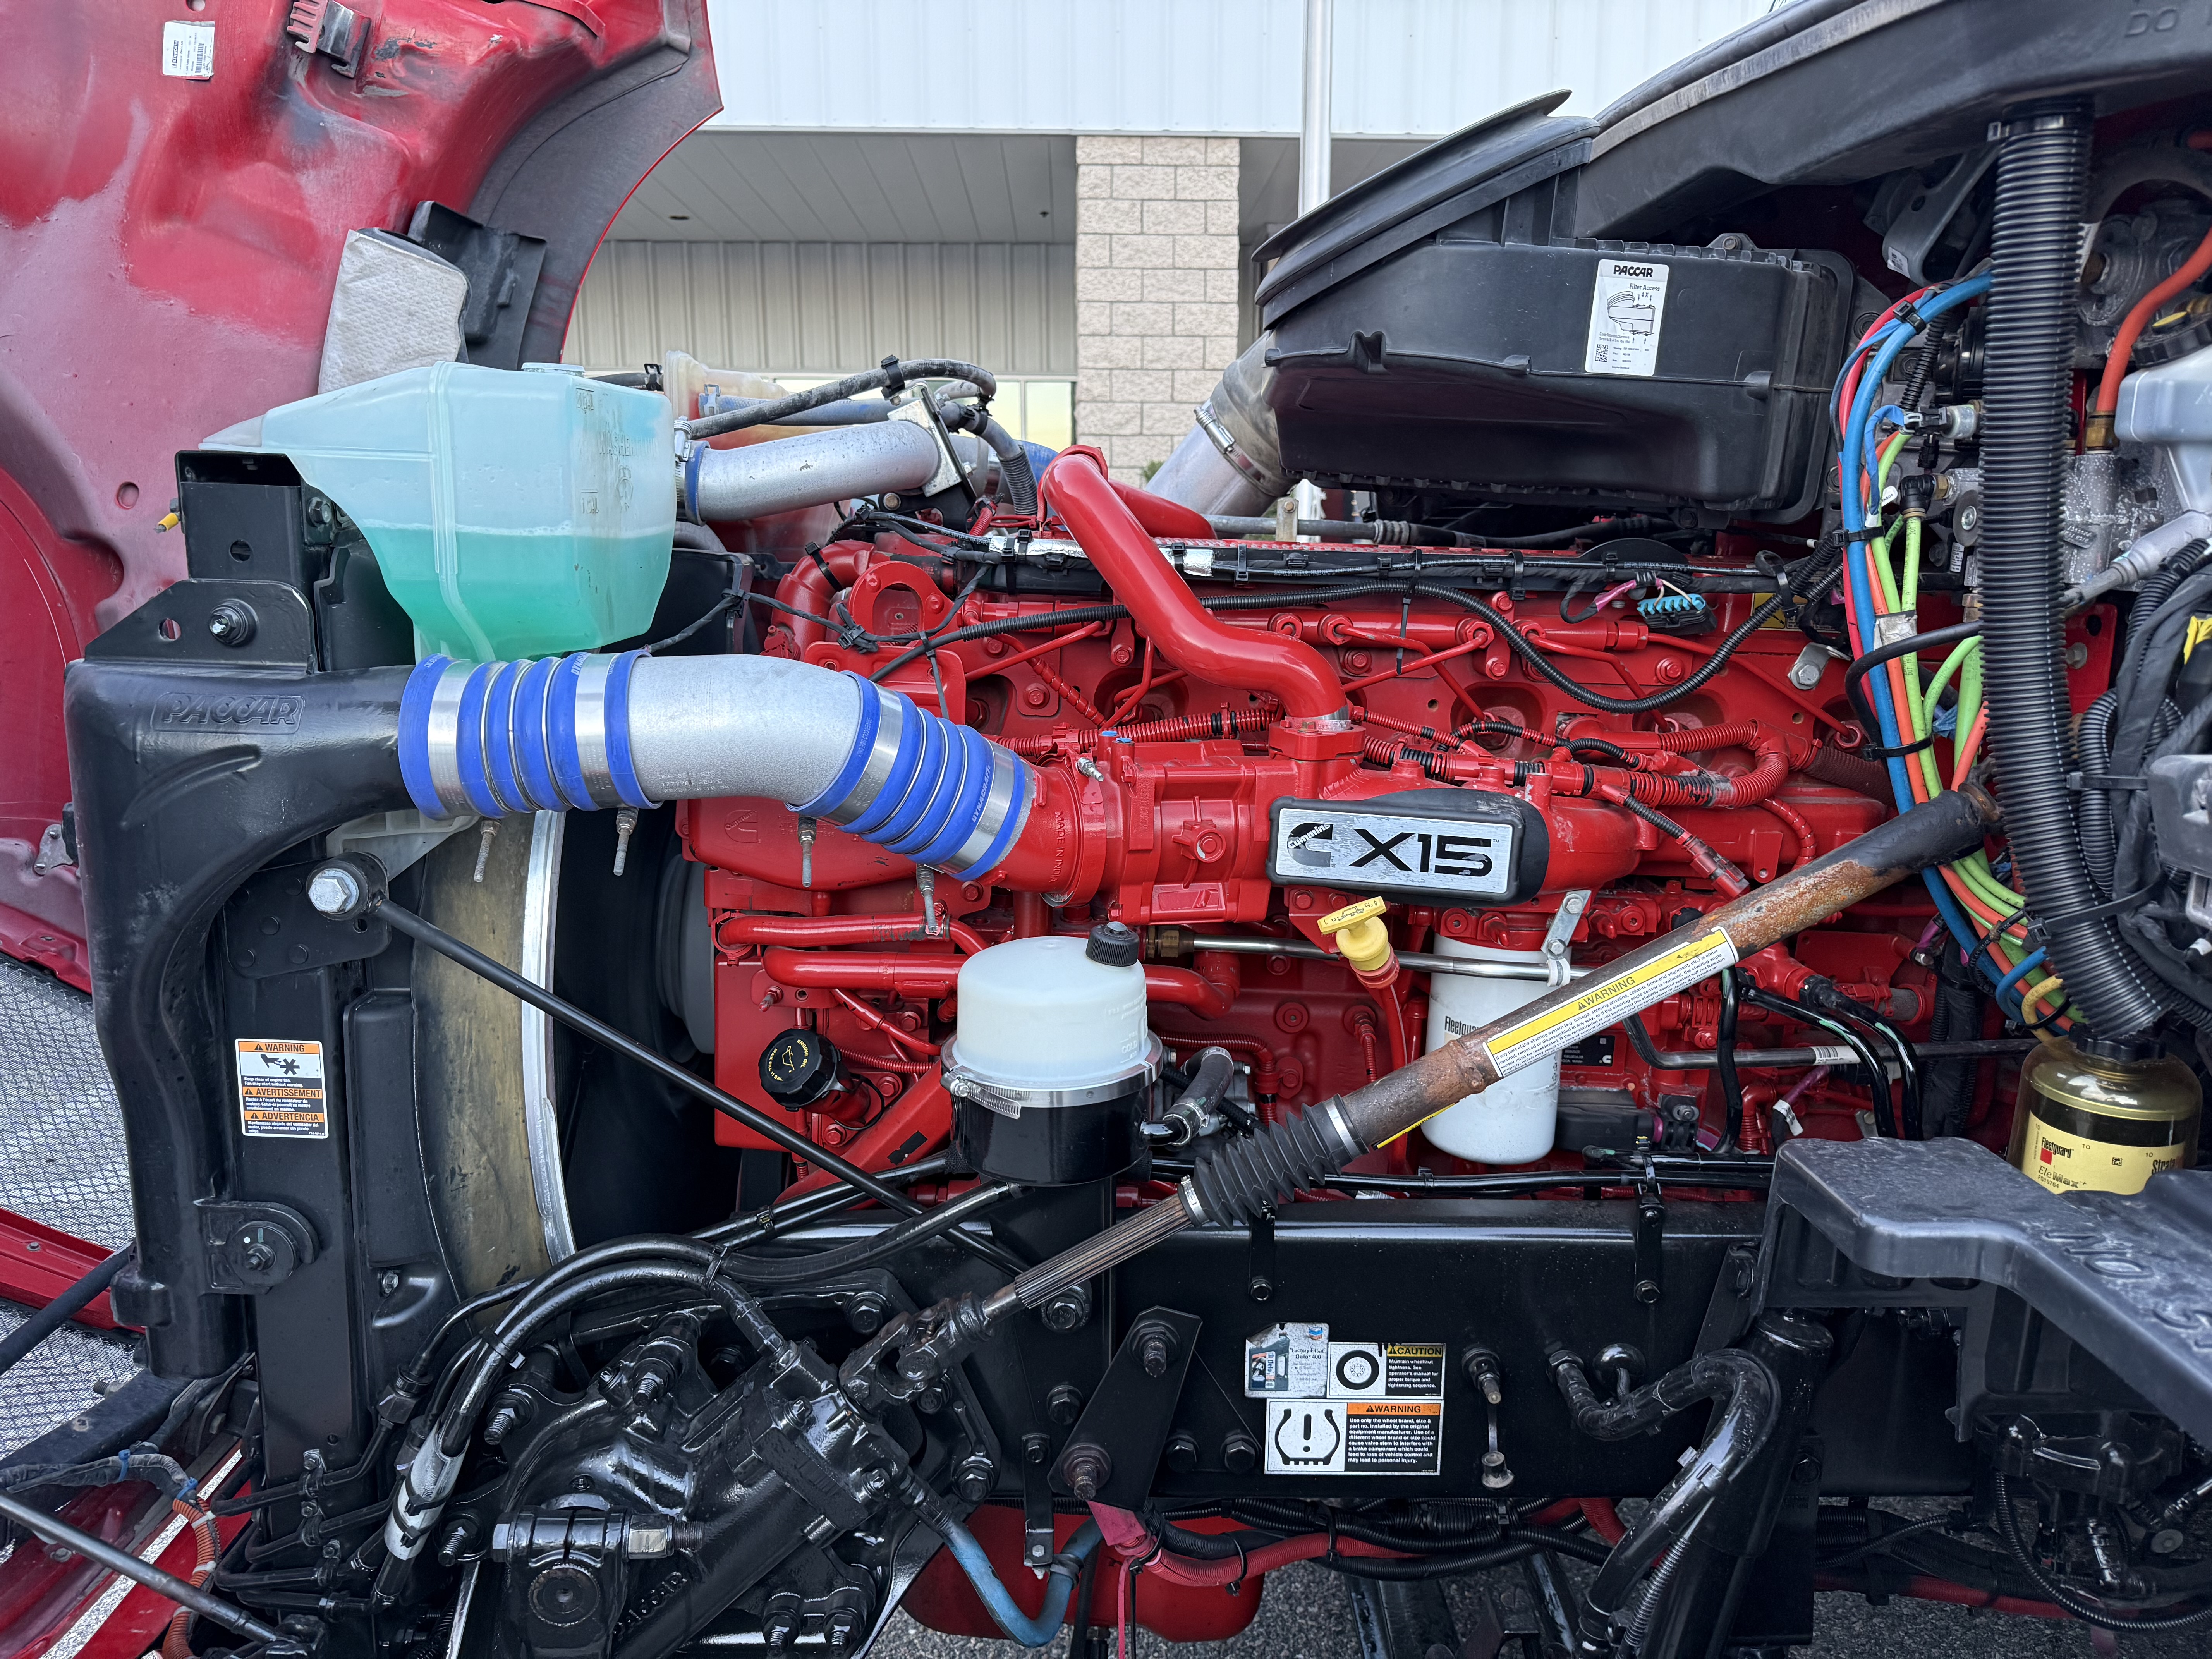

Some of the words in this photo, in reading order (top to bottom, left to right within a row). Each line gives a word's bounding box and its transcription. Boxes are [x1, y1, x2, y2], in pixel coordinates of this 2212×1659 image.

[1613, 265, 1653, 277] PACCAR
[160, 695, 295, 724] PACCAR
[971, 766, 991, 823] DYNACRAFT
[1054, 811, 1066, 845] MADE
[1288, 823, 1331, 849] Cummins
[1056, 847, 1064, 857] IN
[1348, 828, 1493, 878] X15
[1049, 860, 1064, 883] INDIA
[1583, 975, 1635, 1006] WARNING
[265, 1043, 305, 1052] WARNING
[769, 1048, 778, 1060] MAX
[797, 1039, 809, 1057] ENGINE
[1121, 1040, 1137, 1054] COLD
[800, 1058, 808, 1068] OIL
[256, 1088, 321, 1097] AVERTISSEMENT
[262, 1112, 319, 1121] ADVERTENCIA
[2042, 1137, 2072, 1159] Fleetguard
[2037, 1175, 2059, 1189] FS19764
